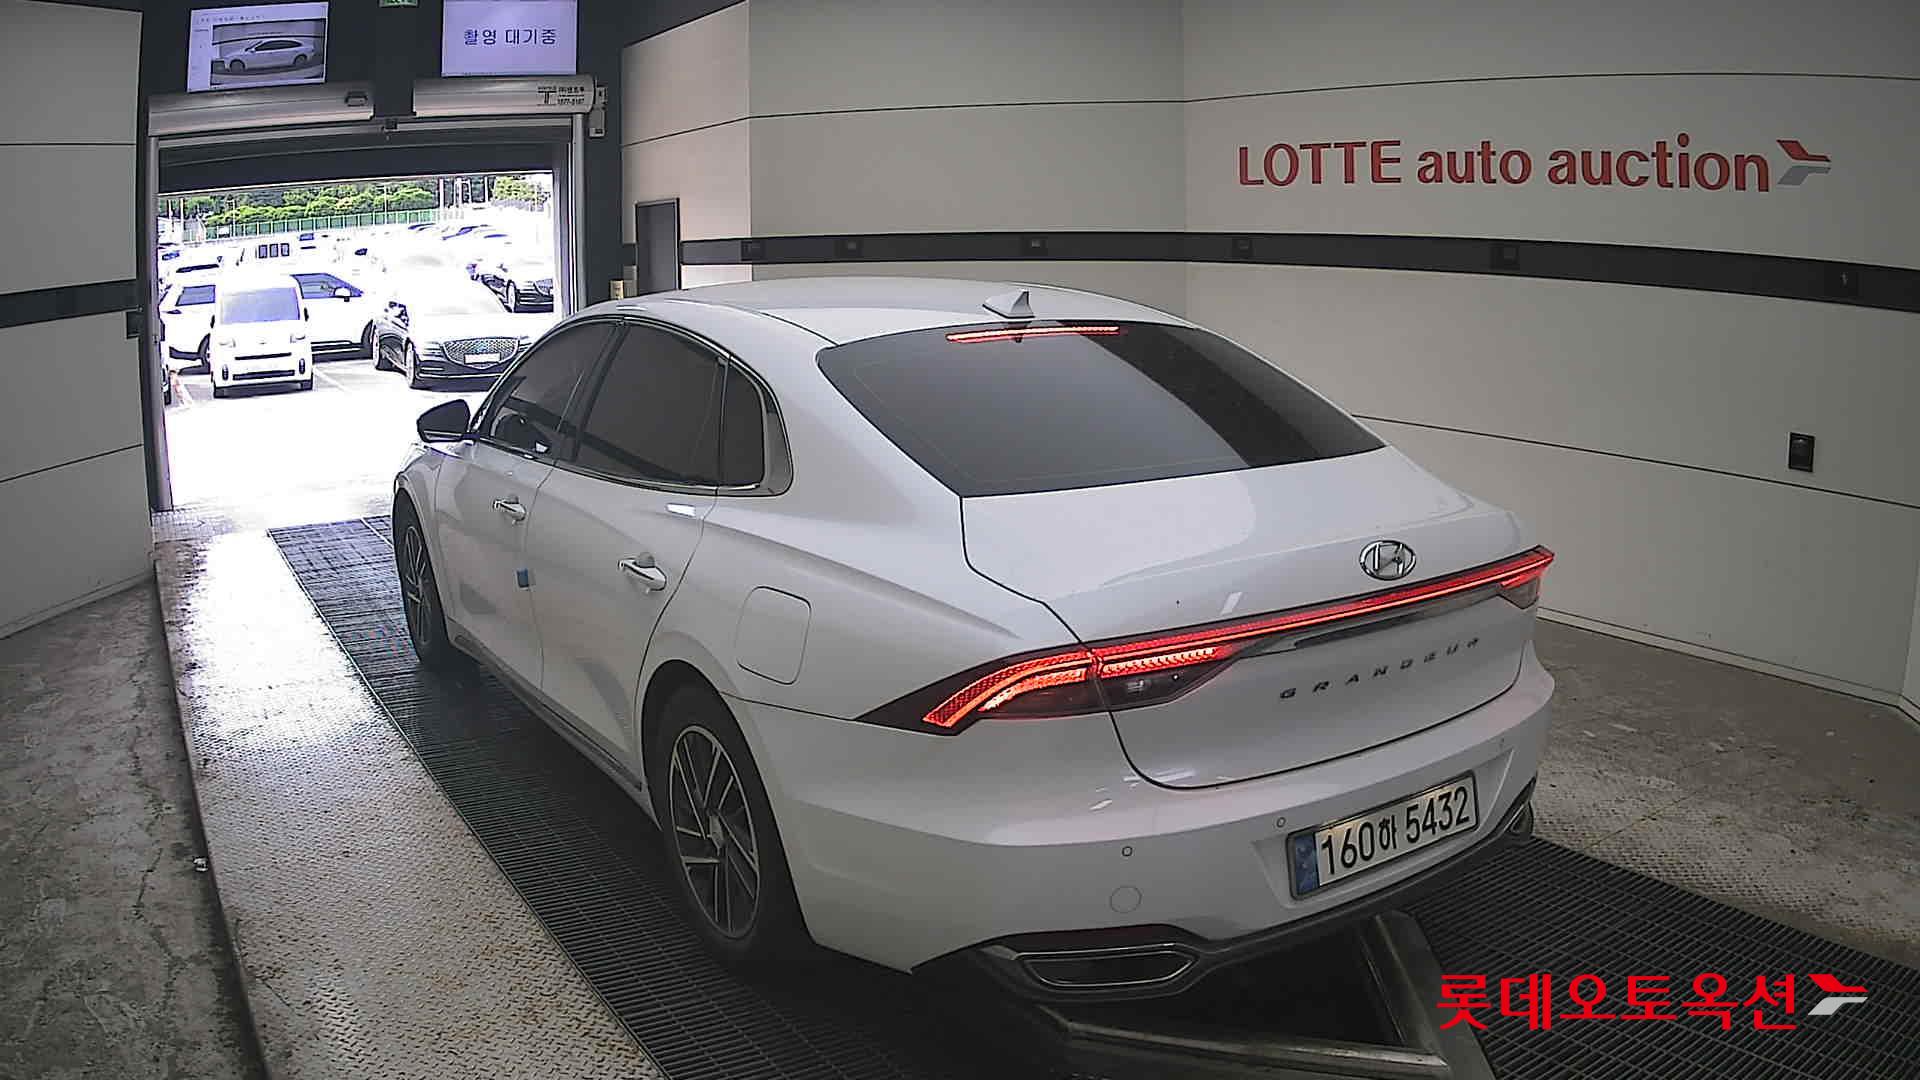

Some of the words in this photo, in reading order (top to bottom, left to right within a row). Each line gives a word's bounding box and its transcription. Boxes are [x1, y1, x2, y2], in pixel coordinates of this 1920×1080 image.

[463, 28, 497, 46] 촬영
[505, 28, 557, 45] 대기중
[1239, 141, 1399, 186] LOTTE
[1417, 142, 1532, 184] auto
[1548, 135, 1768, 191] auction
[1279, 637, 1480, 700] GRANDEUR
[1321, 814, 1397, 875] 160하
[1406, 786, 1471, 844] 5432
